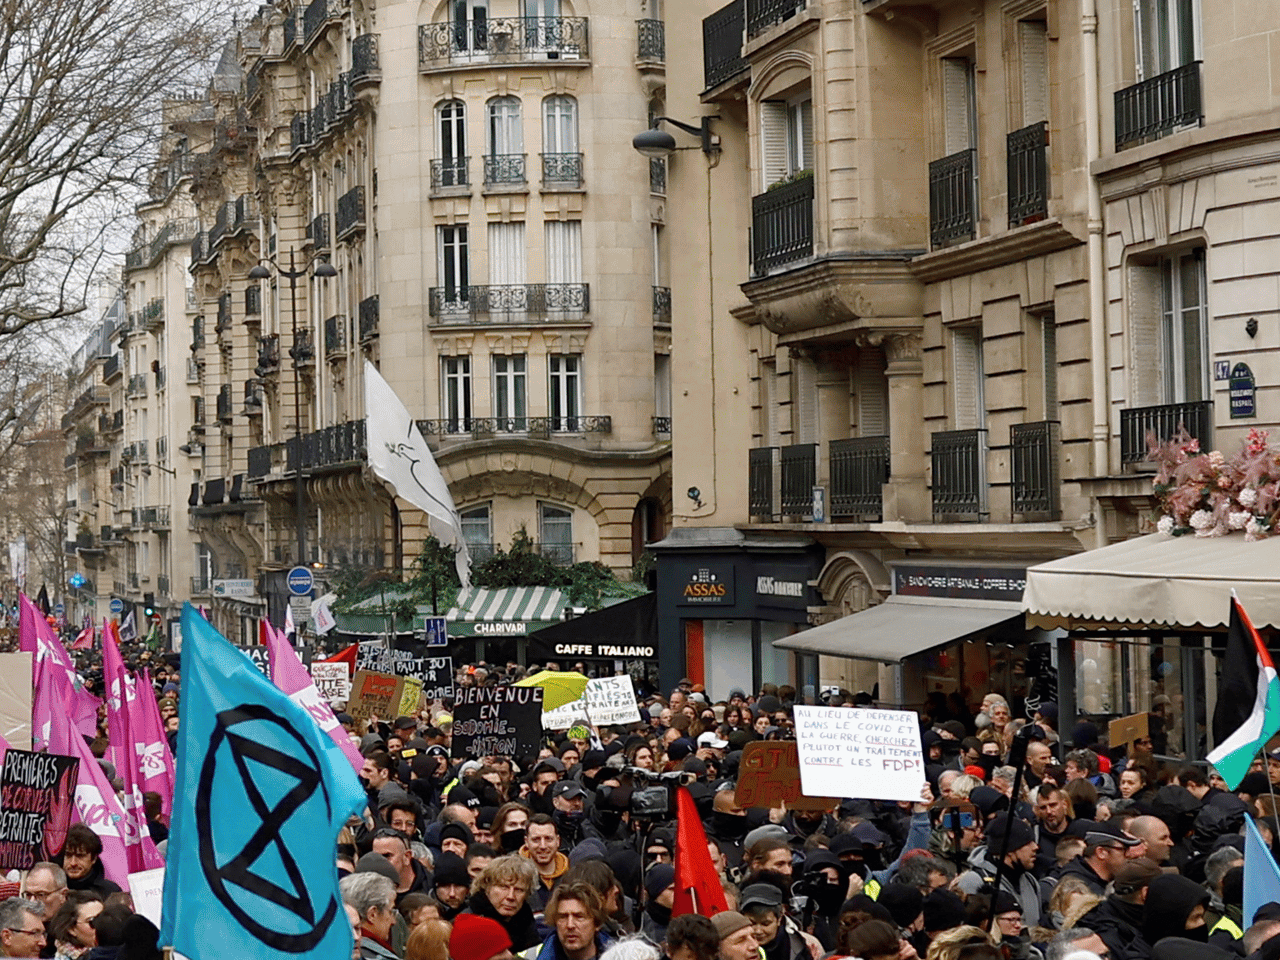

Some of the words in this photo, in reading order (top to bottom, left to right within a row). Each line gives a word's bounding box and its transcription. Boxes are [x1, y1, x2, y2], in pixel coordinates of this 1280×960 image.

[684, 583, 726, 596] ASSAS
[983, 578, 1007, 590] COFFEE
[474, 623, 527, 634] CHARIVARI
[555, 643, 592, 655] CAFFE
[598, 645, 654, 657] ITALIANO
[397, 660, 423, 673] FAUT
[315, 680, 344, 688] UTTE
[455, 687, 544, 705] BIENVENUE
[480, 704, 500, 719] EN
[798, 710, 811, 718] AU
[817, 710, 842, 719] LIEU
[847, 711, 860, 719] DE
[803, 721, 828, 730] DANS
[835, 721, 850, 730] LE
[857, 722, 892, 733] COVID
[897, 726, 914, 735] ET
[865, 735, 916, 748] CHERCHEZ
[846, 745, 859, 753] UN
[804, 756, 843, 766] CONTRE
[850, 758, 872, 767] LES
